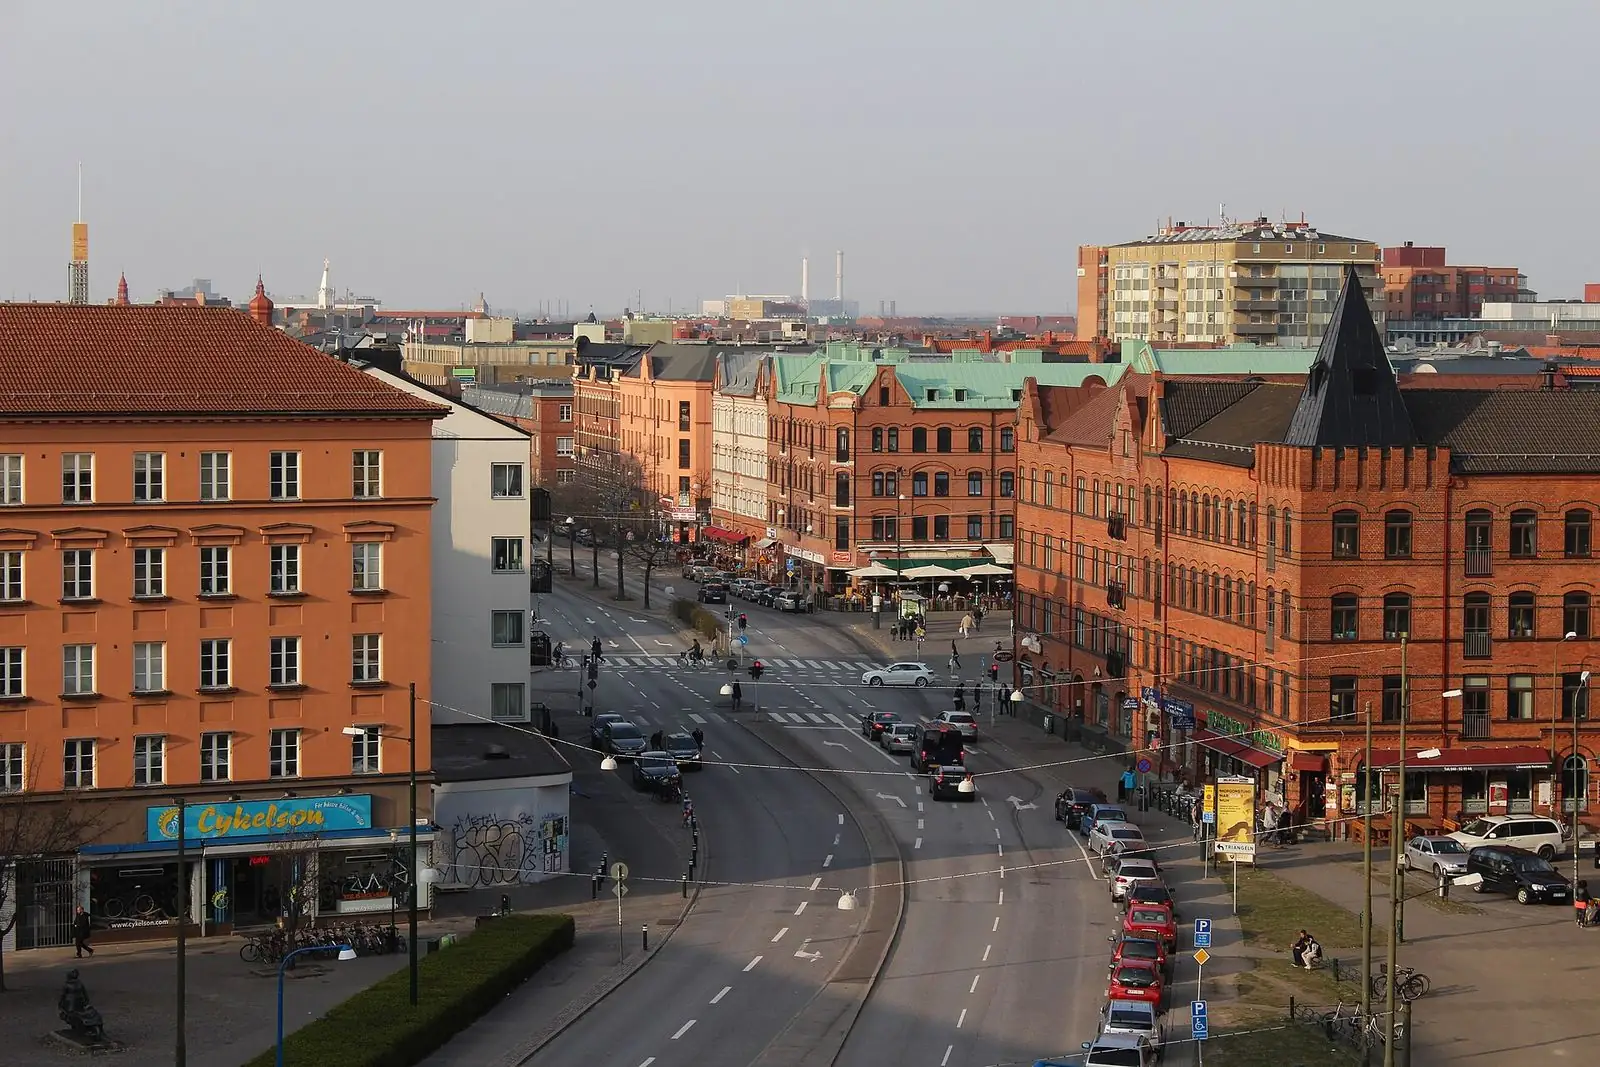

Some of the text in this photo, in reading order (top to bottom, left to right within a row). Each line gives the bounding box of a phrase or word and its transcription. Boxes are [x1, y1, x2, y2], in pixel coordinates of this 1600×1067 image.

[198, 803, 324, 836] Cykelson
[111, 919, 169, 928] www.cykelson.com
[1199, 920, 1208, 931] P
[1194, 1002, 1204, 1014] P
